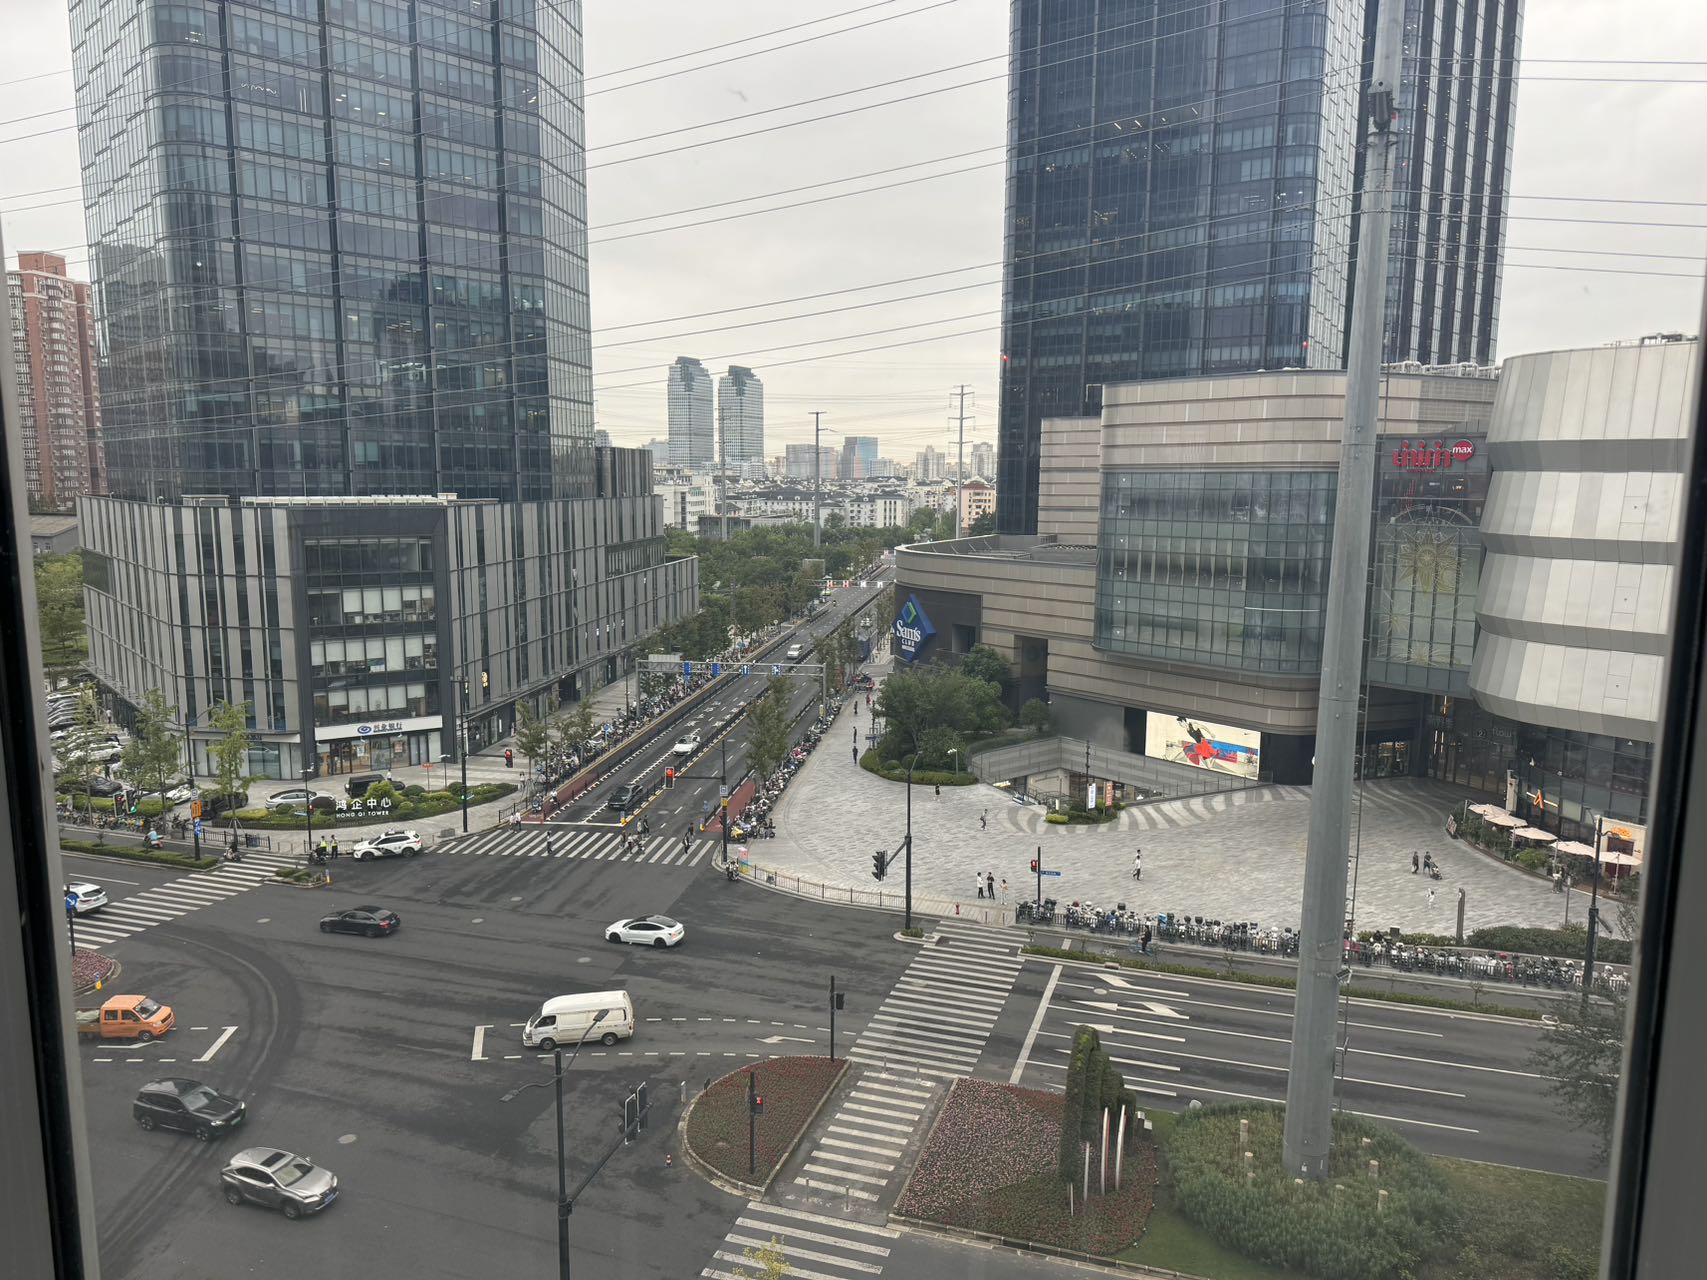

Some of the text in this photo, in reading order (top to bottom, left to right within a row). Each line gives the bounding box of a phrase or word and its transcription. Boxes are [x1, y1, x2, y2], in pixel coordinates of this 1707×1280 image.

[1452, 446, 1472, 454] max
[896, 620, 921, 642] Sam's
[335, 796, 392, 811] 鸿企中心
